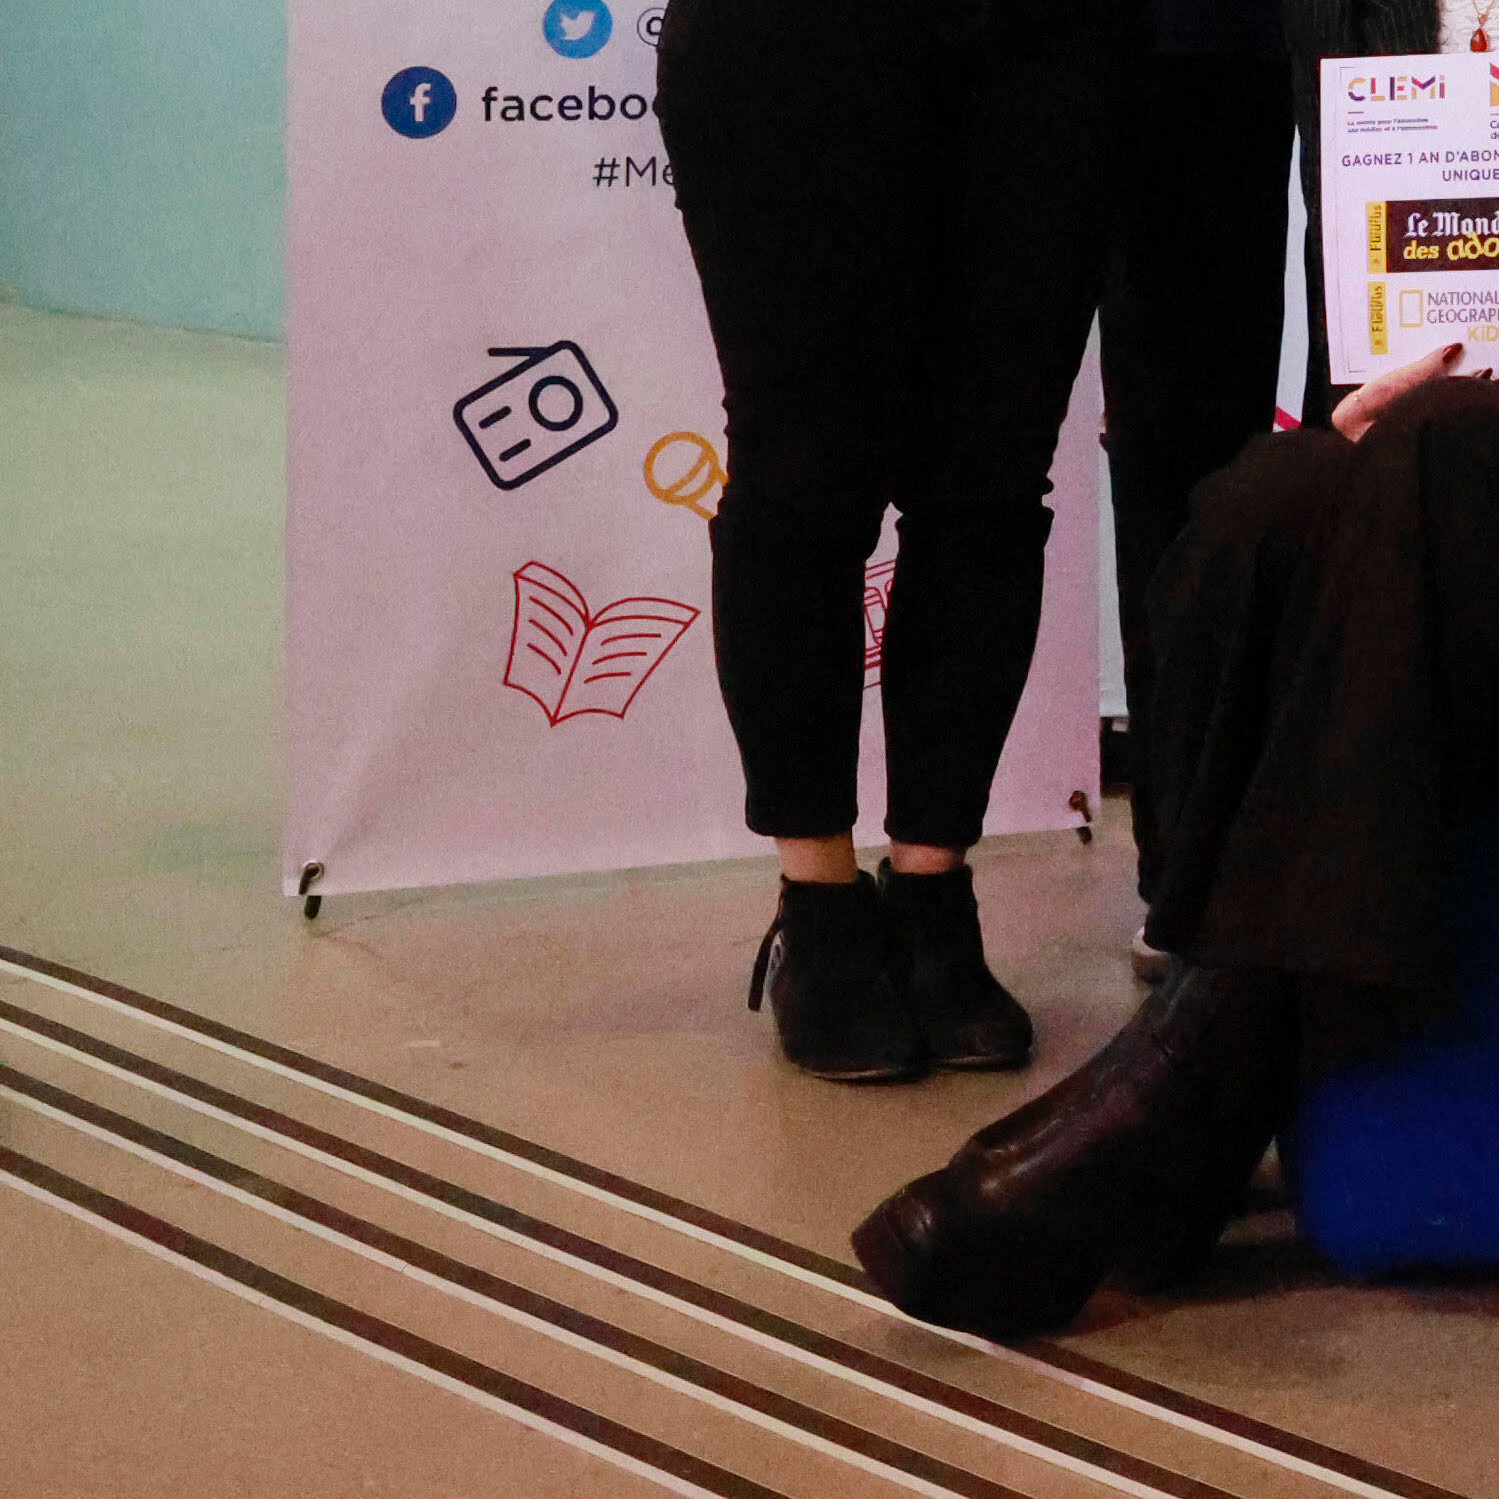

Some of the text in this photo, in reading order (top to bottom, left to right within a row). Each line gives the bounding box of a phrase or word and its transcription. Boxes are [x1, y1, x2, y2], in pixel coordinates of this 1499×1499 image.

[481, 85, 661, 123] facebo
[1342, 153, 1402, 167] GAGNEZ
[1408, 153, 1414, 164] 1
[1419, 151, 1440, 164] AN
[1404, 212, 1429, 238] Le
[1403, 240, 1441, 260] des
